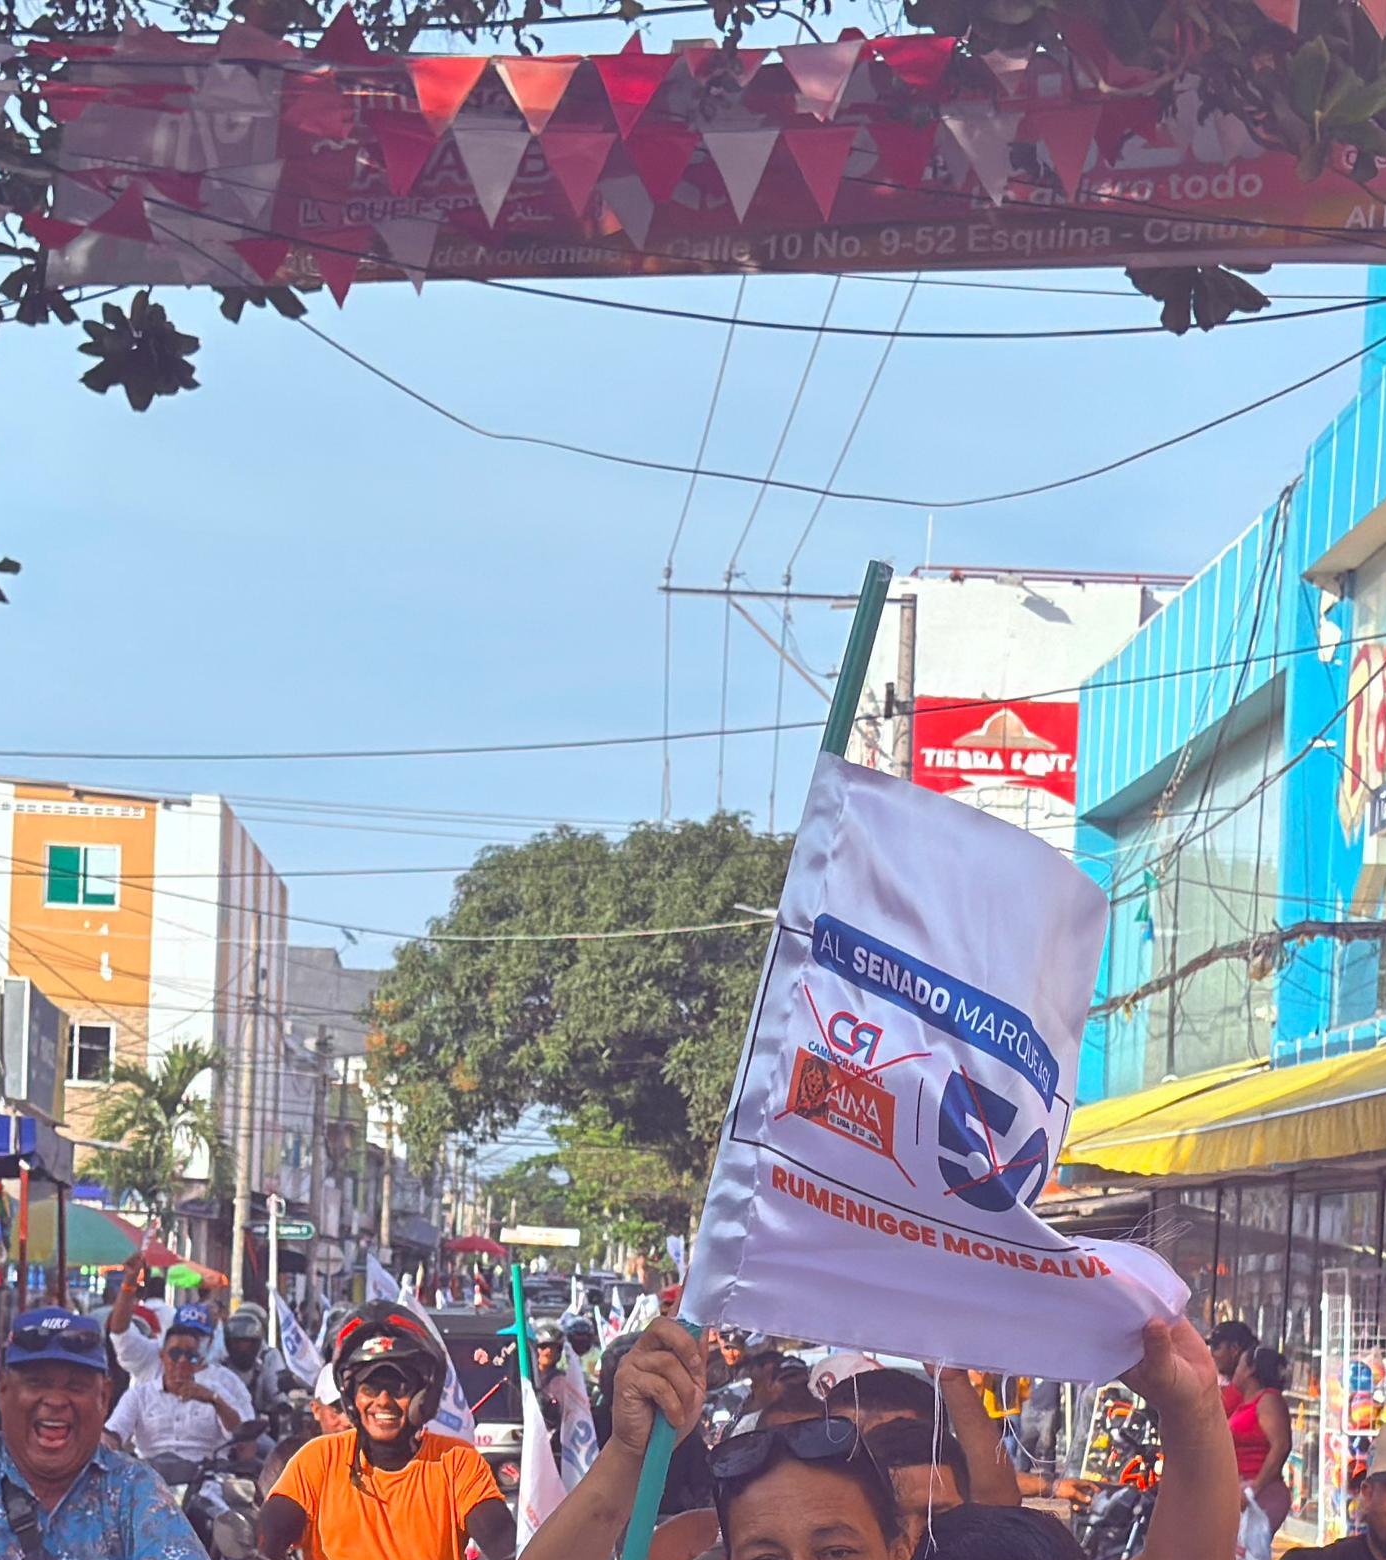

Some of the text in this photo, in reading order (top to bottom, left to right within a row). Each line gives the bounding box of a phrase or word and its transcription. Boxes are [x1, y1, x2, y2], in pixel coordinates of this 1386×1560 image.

[1169, 173, 1264, 201] todo
[1346, 205, 1375, 228] Al
[666, 235, 753, 261] Calle
[764, 232, 803, 260] 10
[814, 229, 867, 259] No.
[880, 226, 956, 256] 9-52
[967, 221, 1111, 256] Esquina
[819, 930, 845, 964] AL
[852, 947, 951, 1015] SENADO
[954, 997, 1039, 1074] MARQUE
[771, 1164, 1112, 1279] RUMENIGGE MONSALVE
